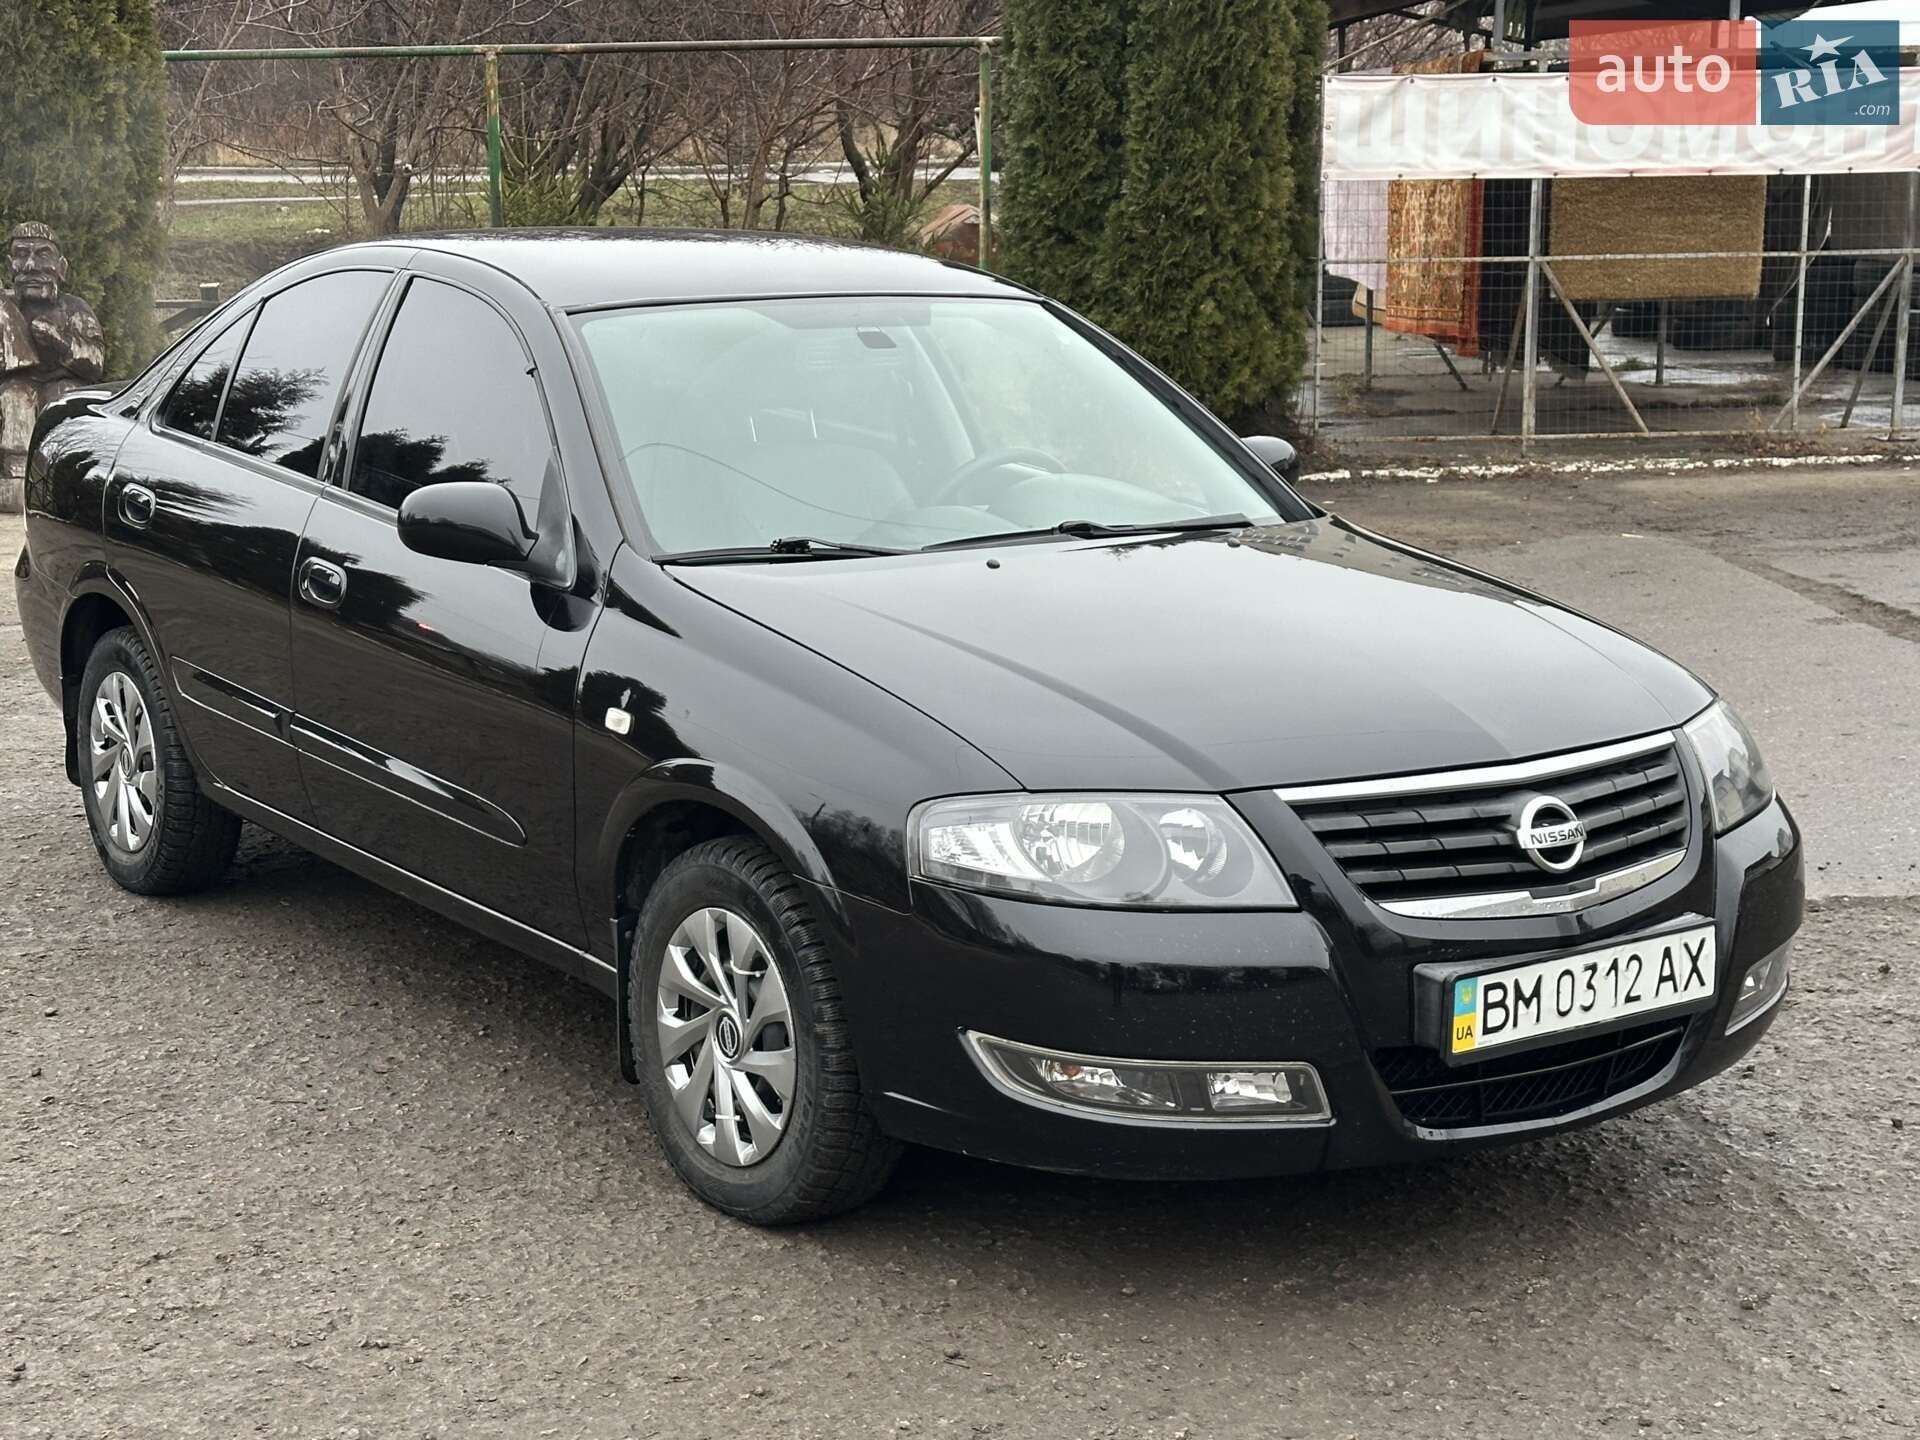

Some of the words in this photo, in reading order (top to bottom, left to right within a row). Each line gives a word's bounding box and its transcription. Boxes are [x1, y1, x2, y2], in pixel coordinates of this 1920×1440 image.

[1530, 823, 1584, 846] NISSAN
[1481, 974, 1543, 1036] BM
[1556, 953, 1643, 1018] 0312
[1654, 937, 1707, 999] AX
[1456, 1024, 1474, 1041] UA
